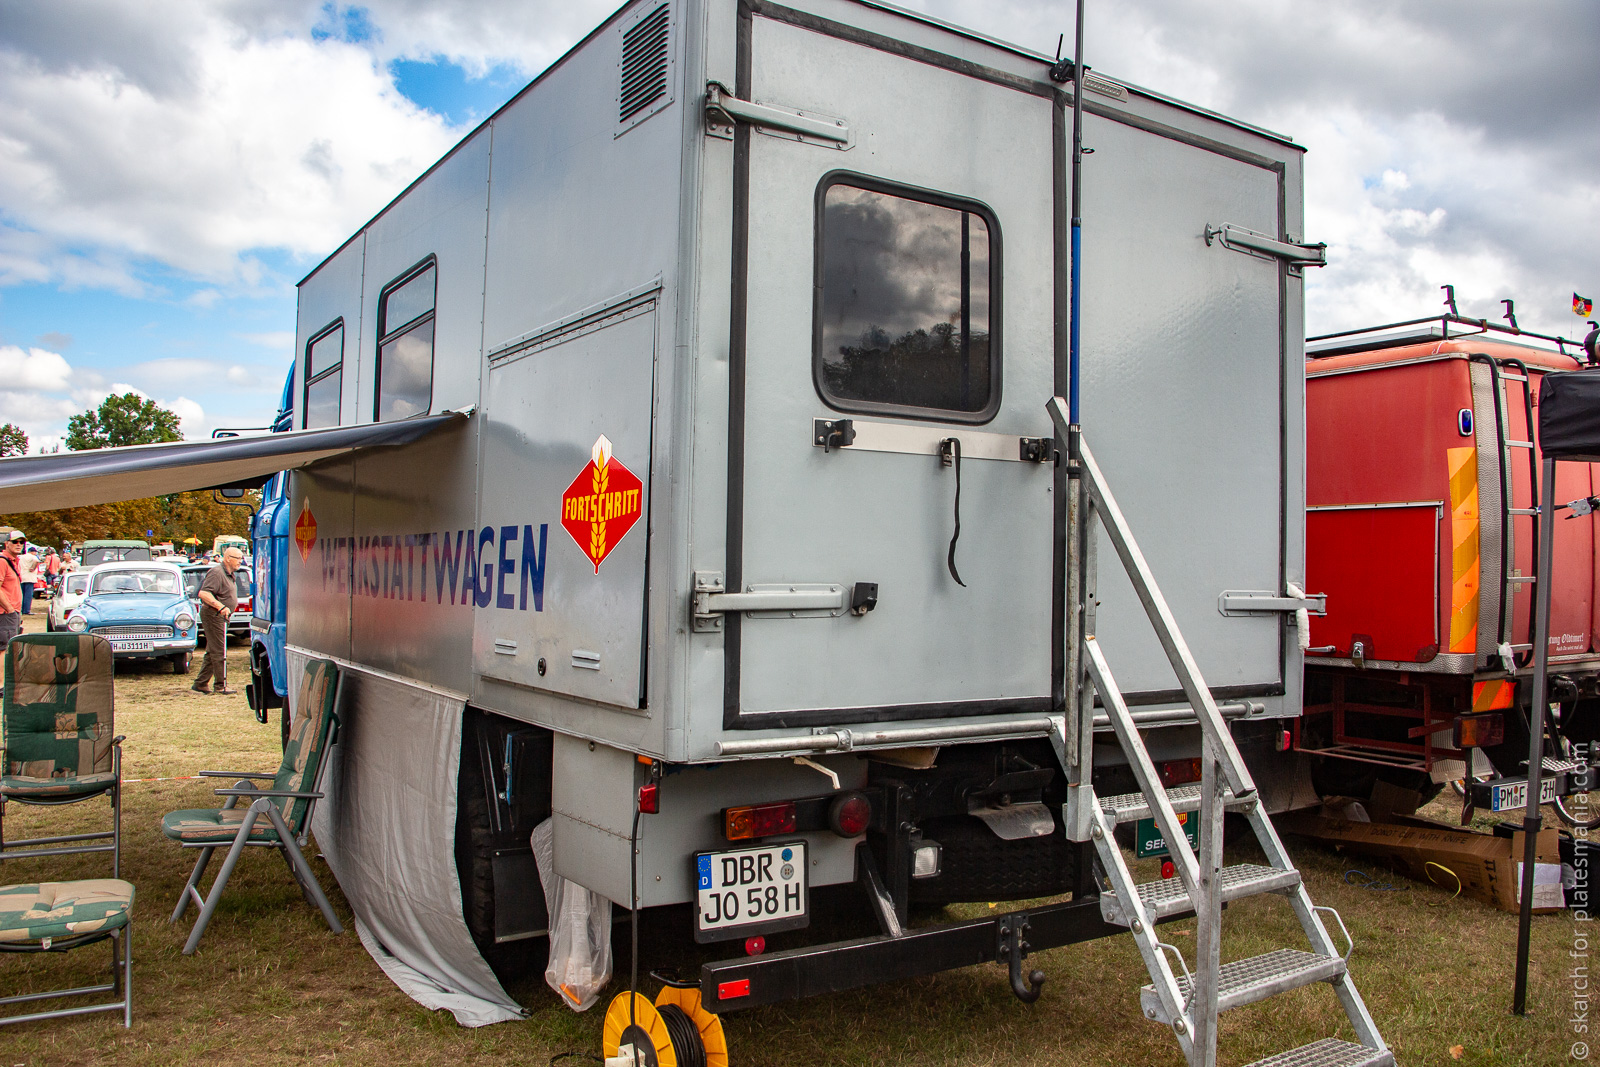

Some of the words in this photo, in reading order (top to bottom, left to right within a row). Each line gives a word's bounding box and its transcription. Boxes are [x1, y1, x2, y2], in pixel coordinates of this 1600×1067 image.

[565, 488, 639, 523] FORTSCHRITT
[320, 523, 549, 613] WERKSTATTWAGEN
[1500, 788, 1513, 807] PM
[1145, 834, 1193, 850] SERE
[1418, 832, 1440, 841] WITH
[1441, 834, 1469, 844] KNIFE
[702, 876, 709, 886] D
[721, 853, 774, 887] DBR
[704, 891, 739, 924] JO
